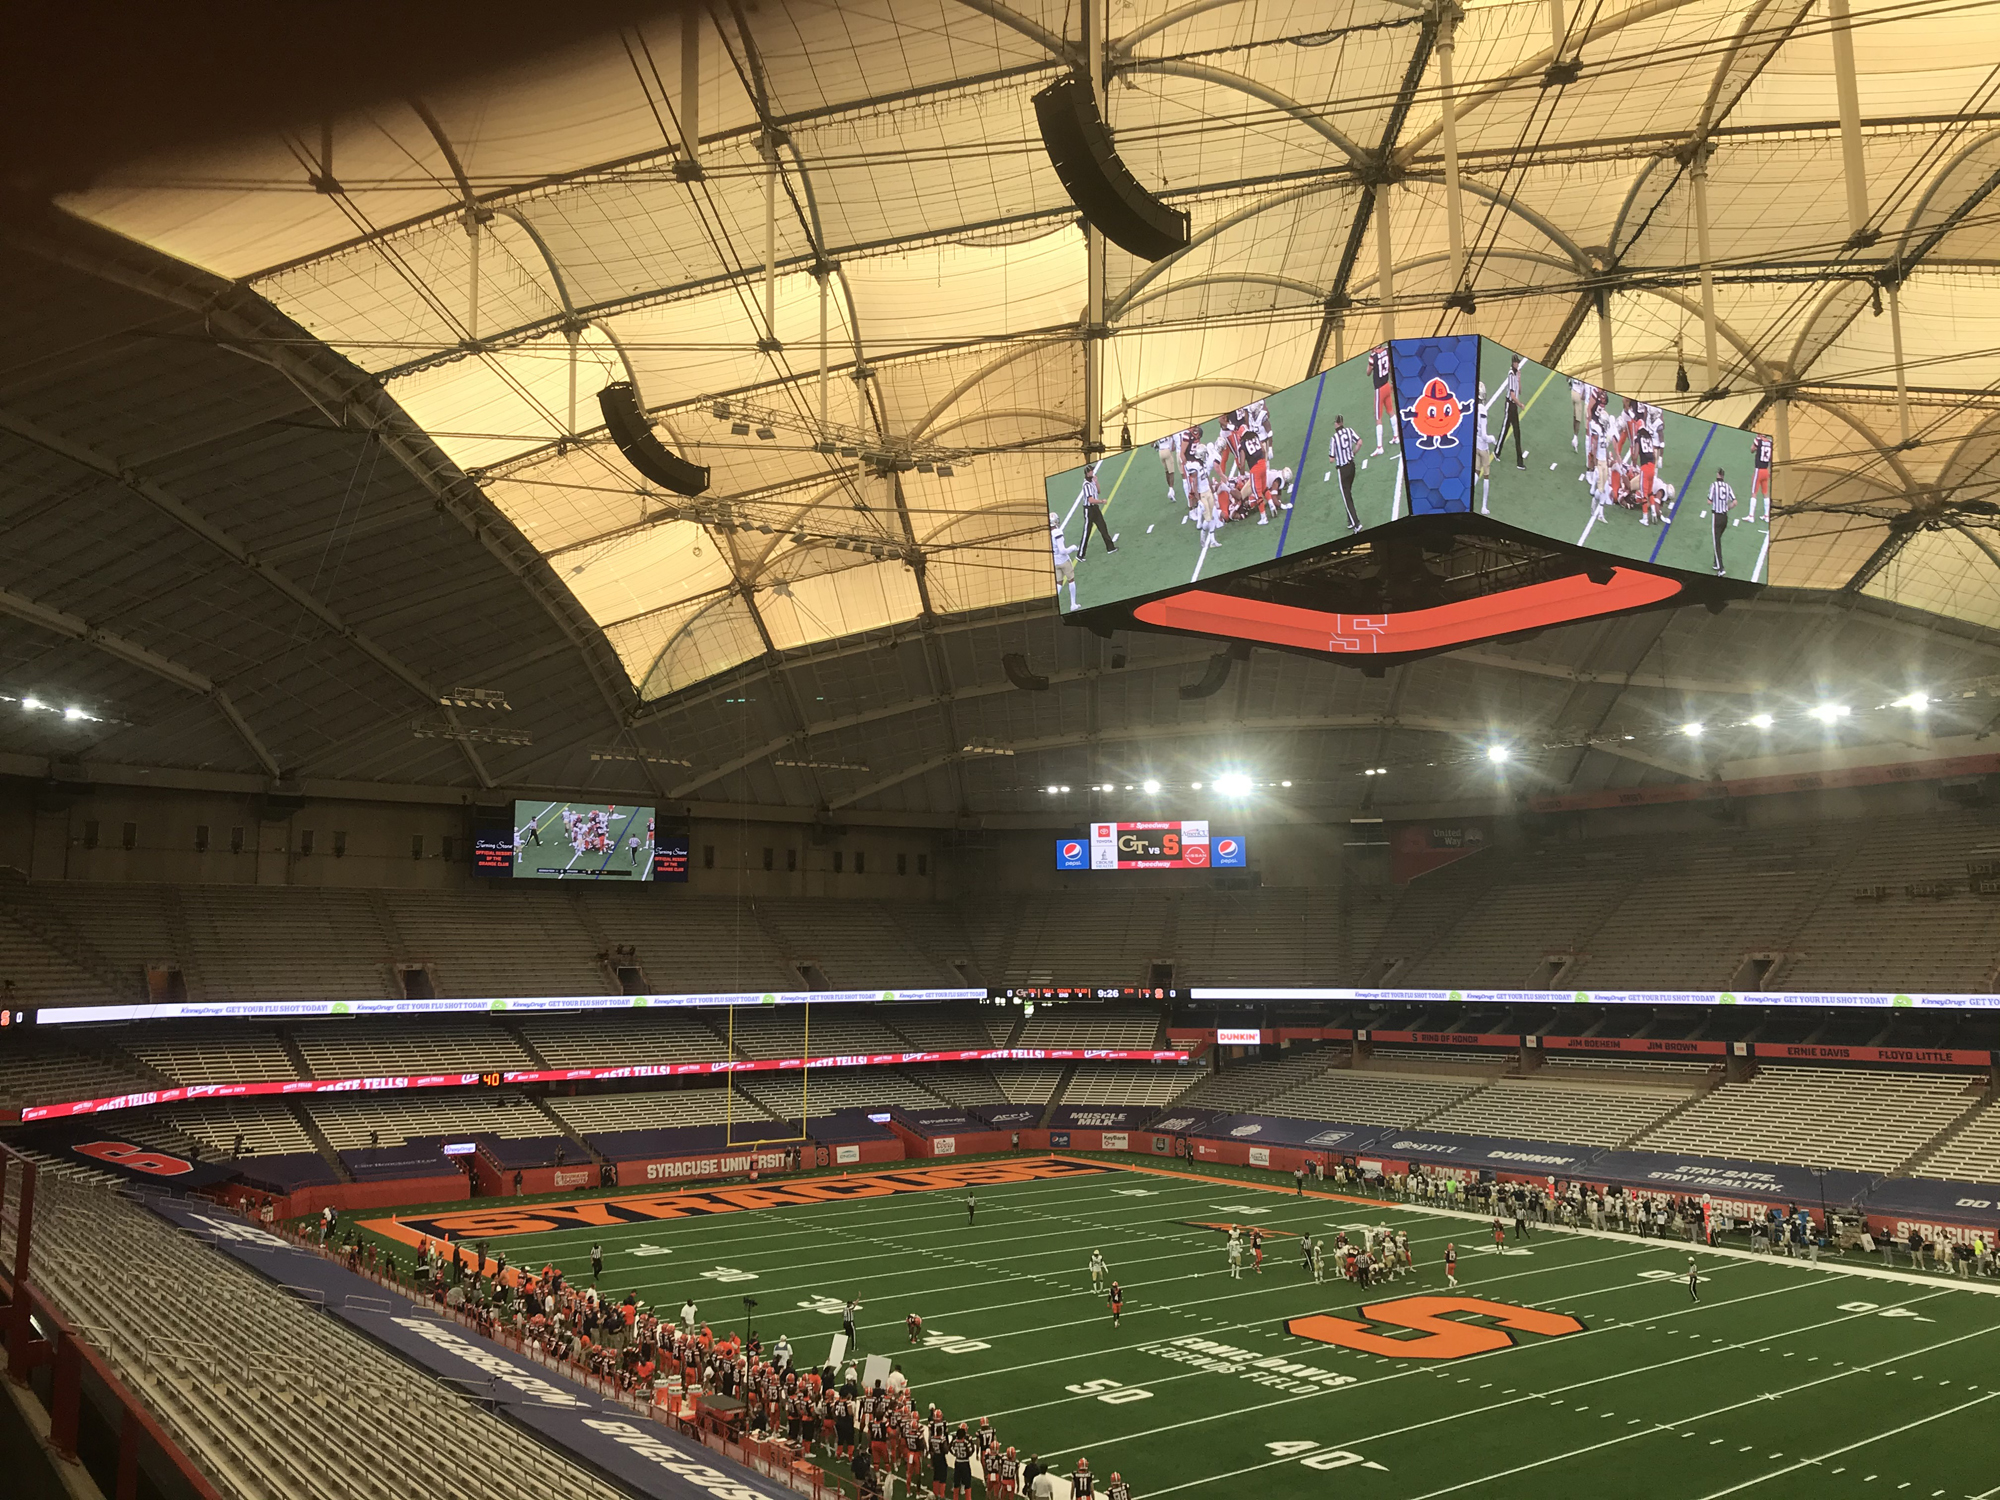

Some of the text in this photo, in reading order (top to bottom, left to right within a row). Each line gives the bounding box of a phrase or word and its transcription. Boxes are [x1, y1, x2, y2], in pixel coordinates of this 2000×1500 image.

[1377, 358, 1389, 378] 13
[1760, 446, 1770, 462] 13
[1434, 829, 1461, 837] United
[1118, 835, 1148, 854] GT
[1162, 834, 1179, 855] S
[1445, 837, 1461, 847] Way
[1098, 989, 1119, 998] 9:26
[1822, 996, 1836, 1004] FLU
[1836, 996, 1858, 1004] SHOT
[264, 1005, 278, 1013] FLU
[302, 1004, 328, 1012] TODAY!
[1412, 1033, 1478, 1043] S RING OF HONOR
[1584, 1040, 1620, 1048] BOEHEIM
[1647, 1042, 1697, 1051] JIM BROWN
[1787, 1047, 1849, 1057] ERNIE DAVIS
[1011, 1049, 1045, 1058] TELLS!
[1878, 1050, 1953, 1062] FLOYD LITTLE
[835, 1056, 867, 1065] TELLS!
[633, 1066, 670, 1076] TELLS!
[363, 1078, 408, 1089] TELLS!
[483, 1073, 500, 1086] 40
[128, 1092, 157, 1108] TELLS!
[991, 1112, 1030, 1122] ACCN
[1070, 1112, 1127, 1120] MUSCLE
[1077, 1118, 1116, 1126] MILK
[1176, 1139, 1185, 1156] S
[818, 1148, 829, 1166] S
[1487, 1150, 1575, 1164] DUNKIN'
[647, 1152, 793, 1179] SYRACUSE UNIVRSIT
[1675, 1166, 1776, 1184] STAY SAFE.
[1648, 1174, 1784, 1192] STAY HEALTHY.
[431, 1160, 1108, 1237] SYRACUSE
[1956, 1199, 1991, 1208] DO
[699, 1268, 759, 1282] 20
[797, 1297, 863, 1314] 30
[1283, 1296, 1590, 1360] S
[922, 1335, 992, 1353] 40
[1170, 1337, 1357, 1386] ERNIE DAVIS
[1137, 1344, 1320, 1394] LEGENDS FIELD
[1065, 1379, 1154, 1404] 50
[1264, 1440, 1364, 1470] 40
[986, 1459, 999, 1471] 24
[1003, 1465, 1015, 1478] 20
[1079, 1477, 1088, 1491] 11
